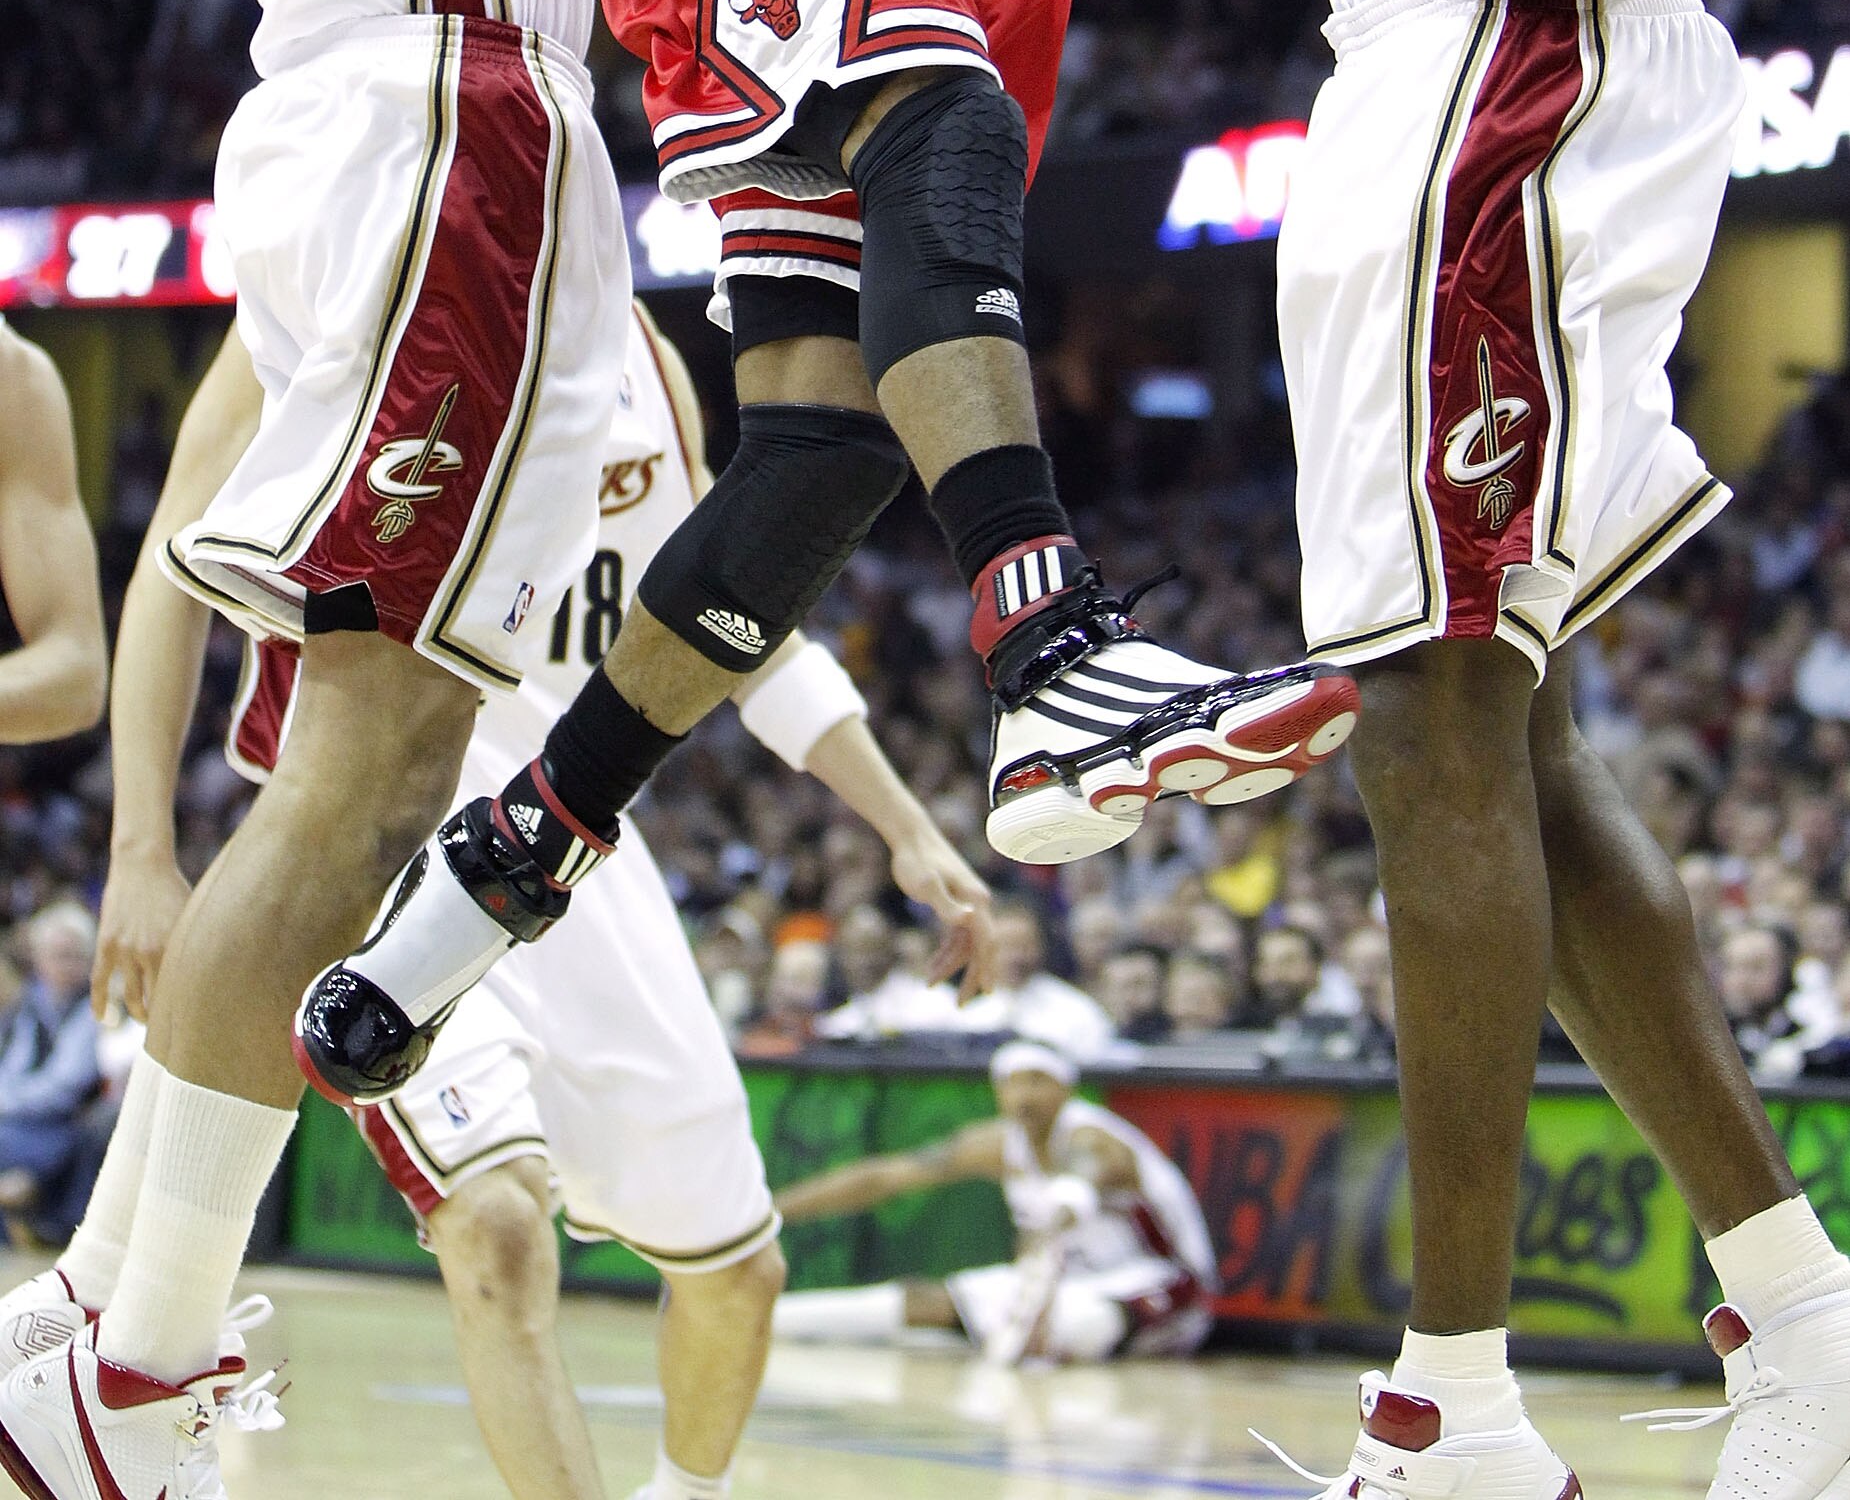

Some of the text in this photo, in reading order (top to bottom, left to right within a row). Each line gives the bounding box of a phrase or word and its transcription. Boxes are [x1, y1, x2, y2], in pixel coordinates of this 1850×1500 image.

[548, 548, 624, 666] 18
[705, 608, 767, 647] adidas
[508, 804, 537, 845] adidas
